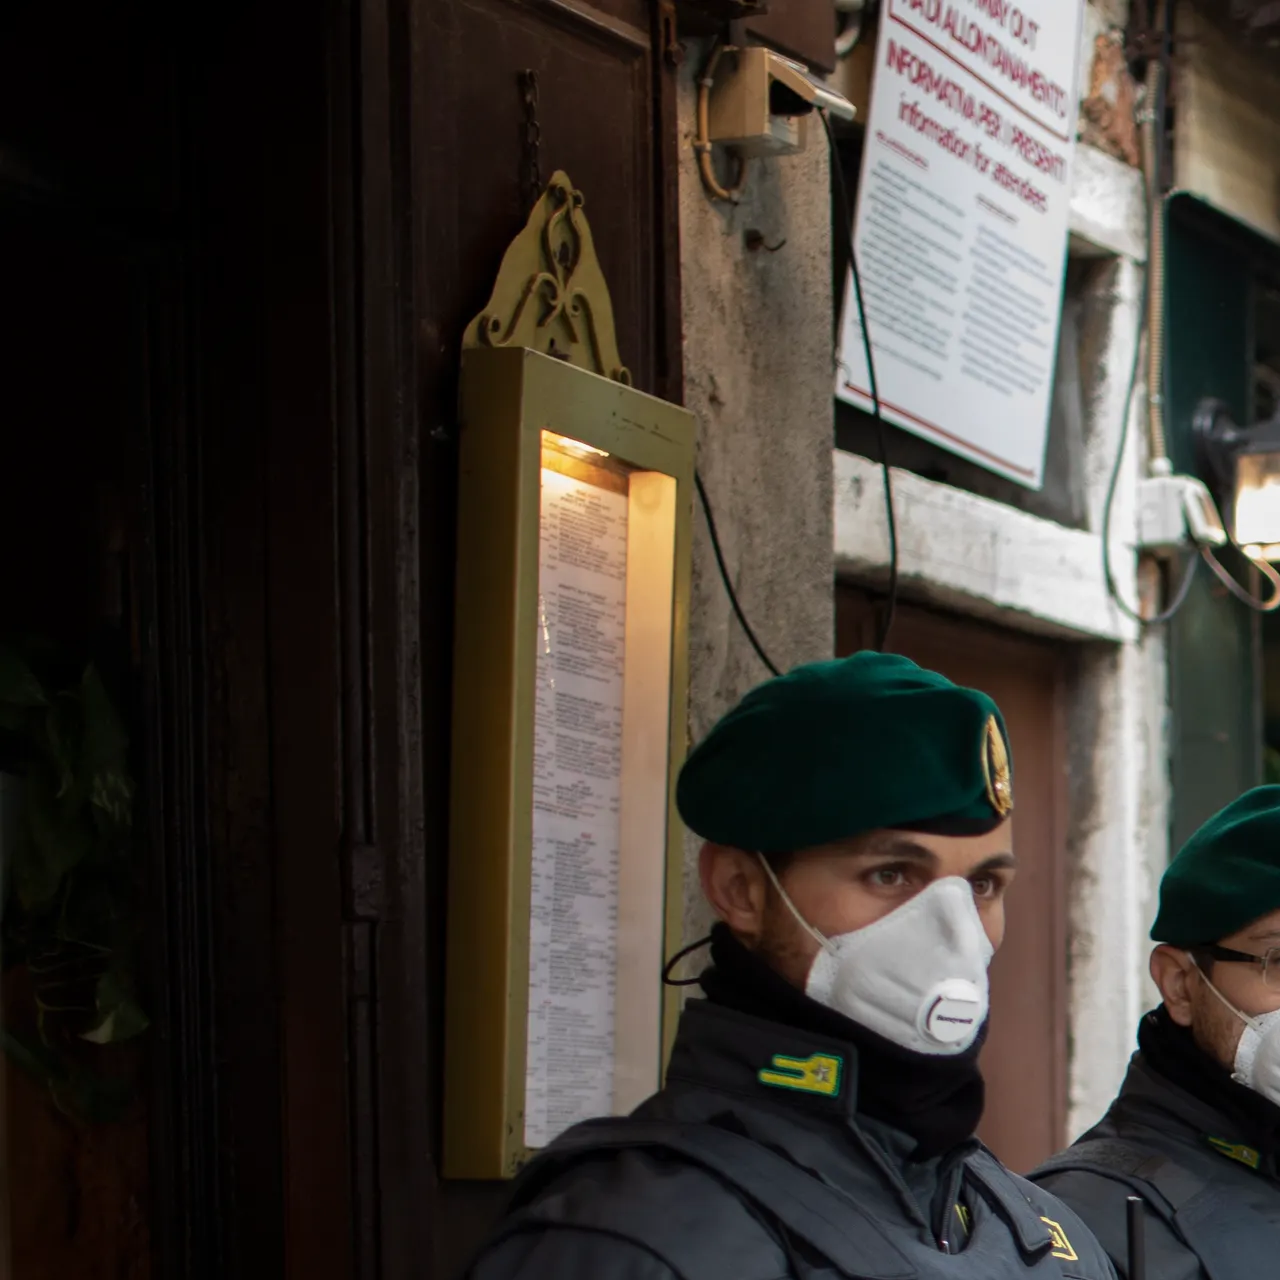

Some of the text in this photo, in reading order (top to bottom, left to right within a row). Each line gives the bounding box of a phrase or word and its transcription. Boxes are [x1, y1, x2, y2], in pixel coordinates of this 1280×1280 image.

[886, 38, 977, 124] INFORMATIVA
[977, 102, 1001, 139] PER
[1012, 125, 1068, 185] PRESENTI
[898, 90, 971, 161] information
[974, 142, 991, 174] for
[991, 161, 1047, 214] attendees
